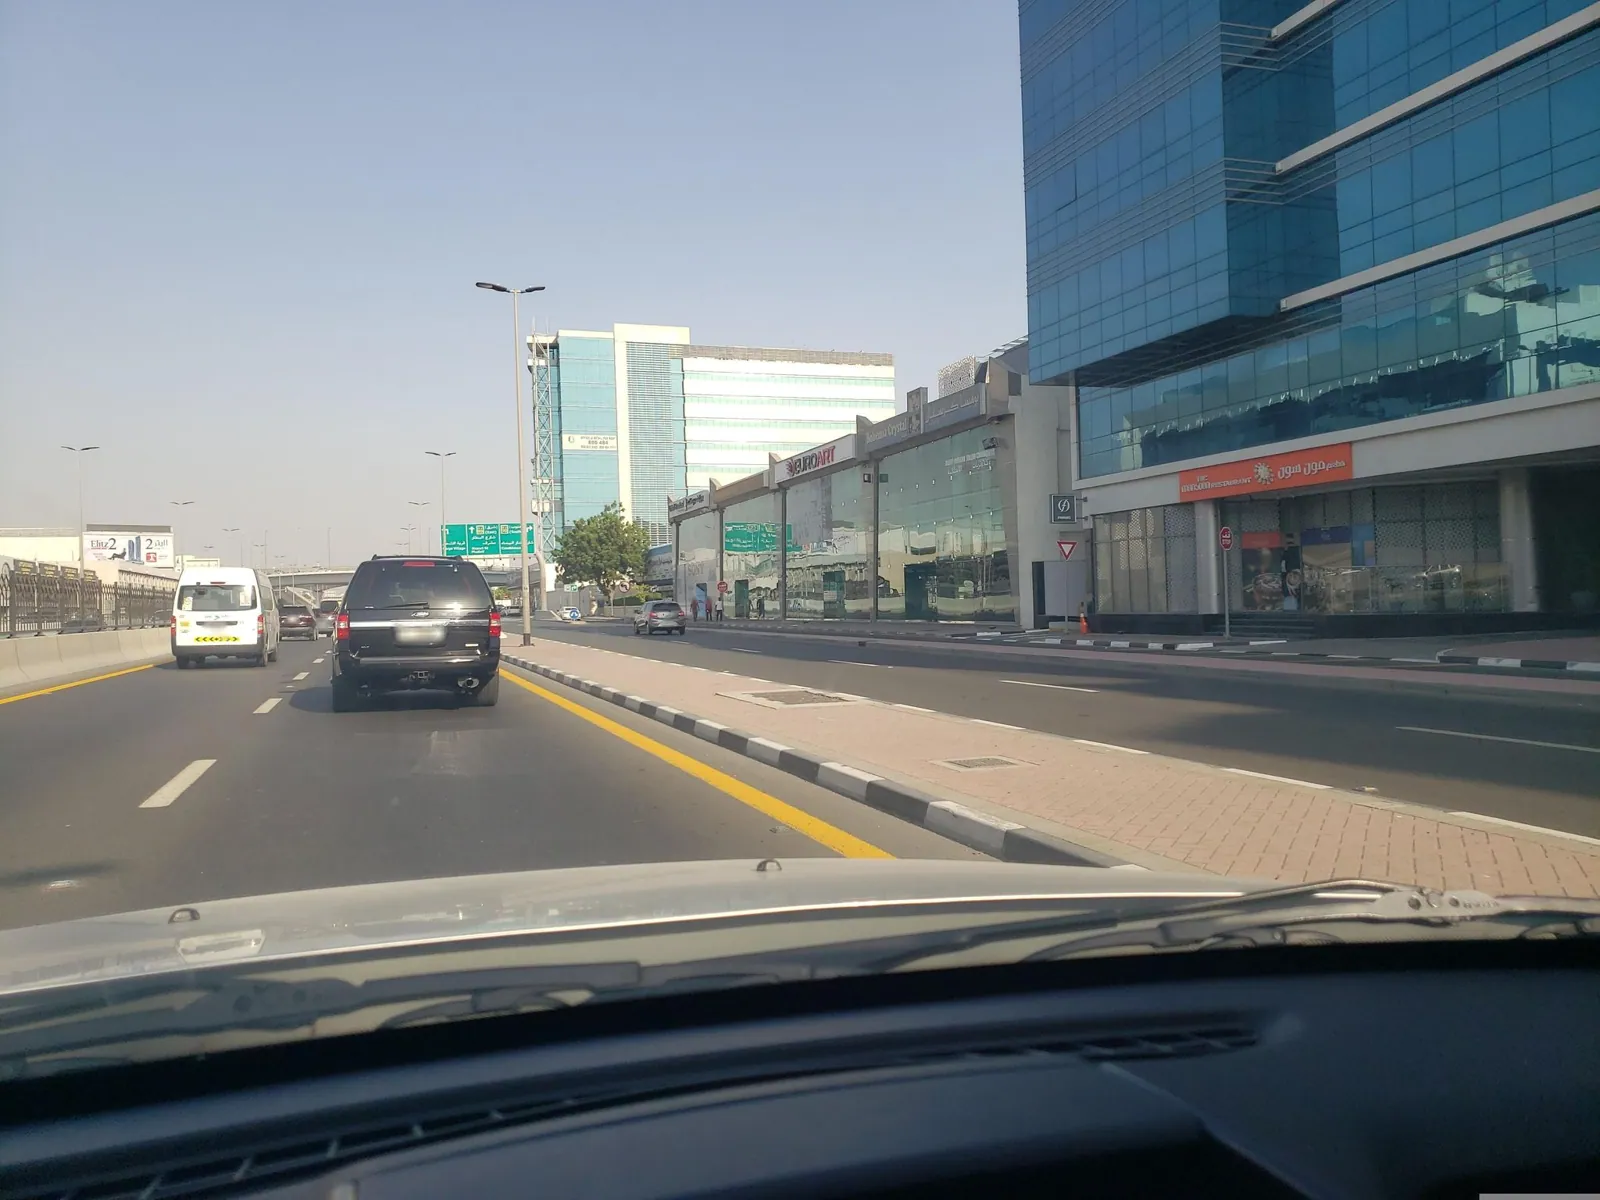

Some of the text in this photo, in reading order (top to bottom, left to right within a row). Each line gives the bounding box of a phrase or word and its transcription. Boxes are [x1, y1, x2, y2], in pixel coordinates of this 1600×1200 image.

[1277, 464, 1302, 480] سون
[1303, 460, 1326, 476] مون
[91, 537, 116, 550] Elitz 2
[145, 538, 153, 549] 2
